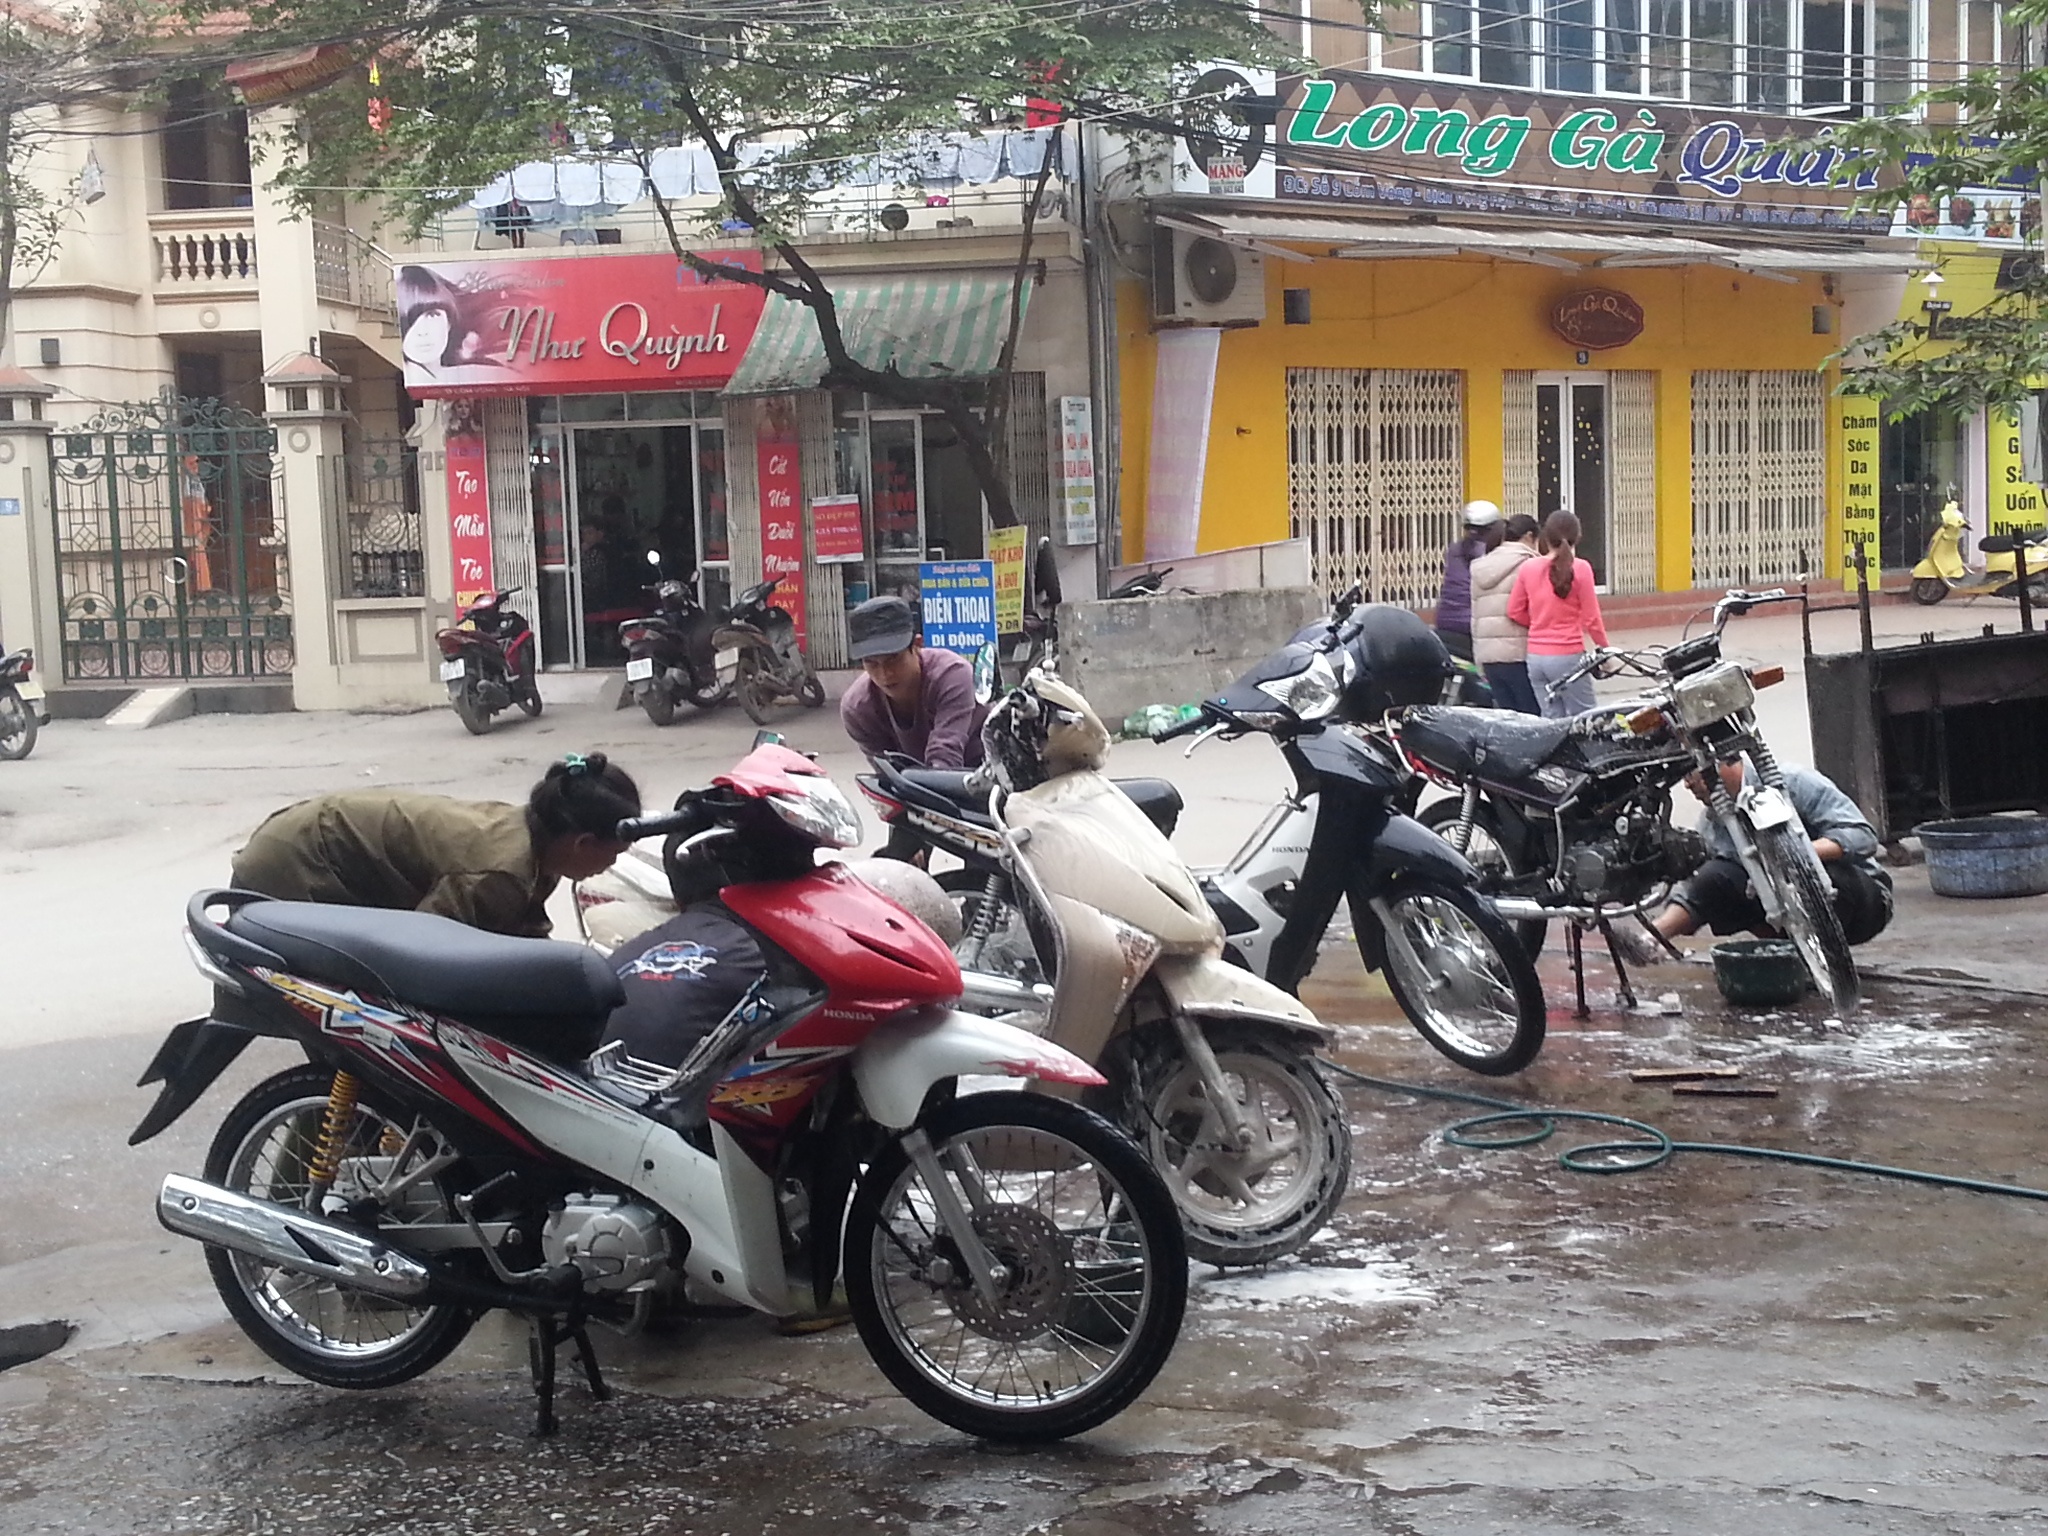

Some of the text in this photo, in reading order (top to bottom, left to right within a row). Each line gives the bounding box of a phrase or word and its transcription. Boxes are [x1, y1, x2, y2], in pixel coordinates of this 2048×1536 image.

[1286, 79, 1532, 177] Long
[1550, 106, 1666, 175] Gà
[499, 301, 730, 371] Như Quỳnh
[1850, 459, 1868, 475] Da
[455, 469, 479, 500] Tạo
[2005, 488, 2037, 512] Uốn
[923, 591, 991, 630] ĐIỆN THOẠI
[931, 630, 986, 650] DI ĐỘNG
[823, 1008, 876, 1021] HONDA
